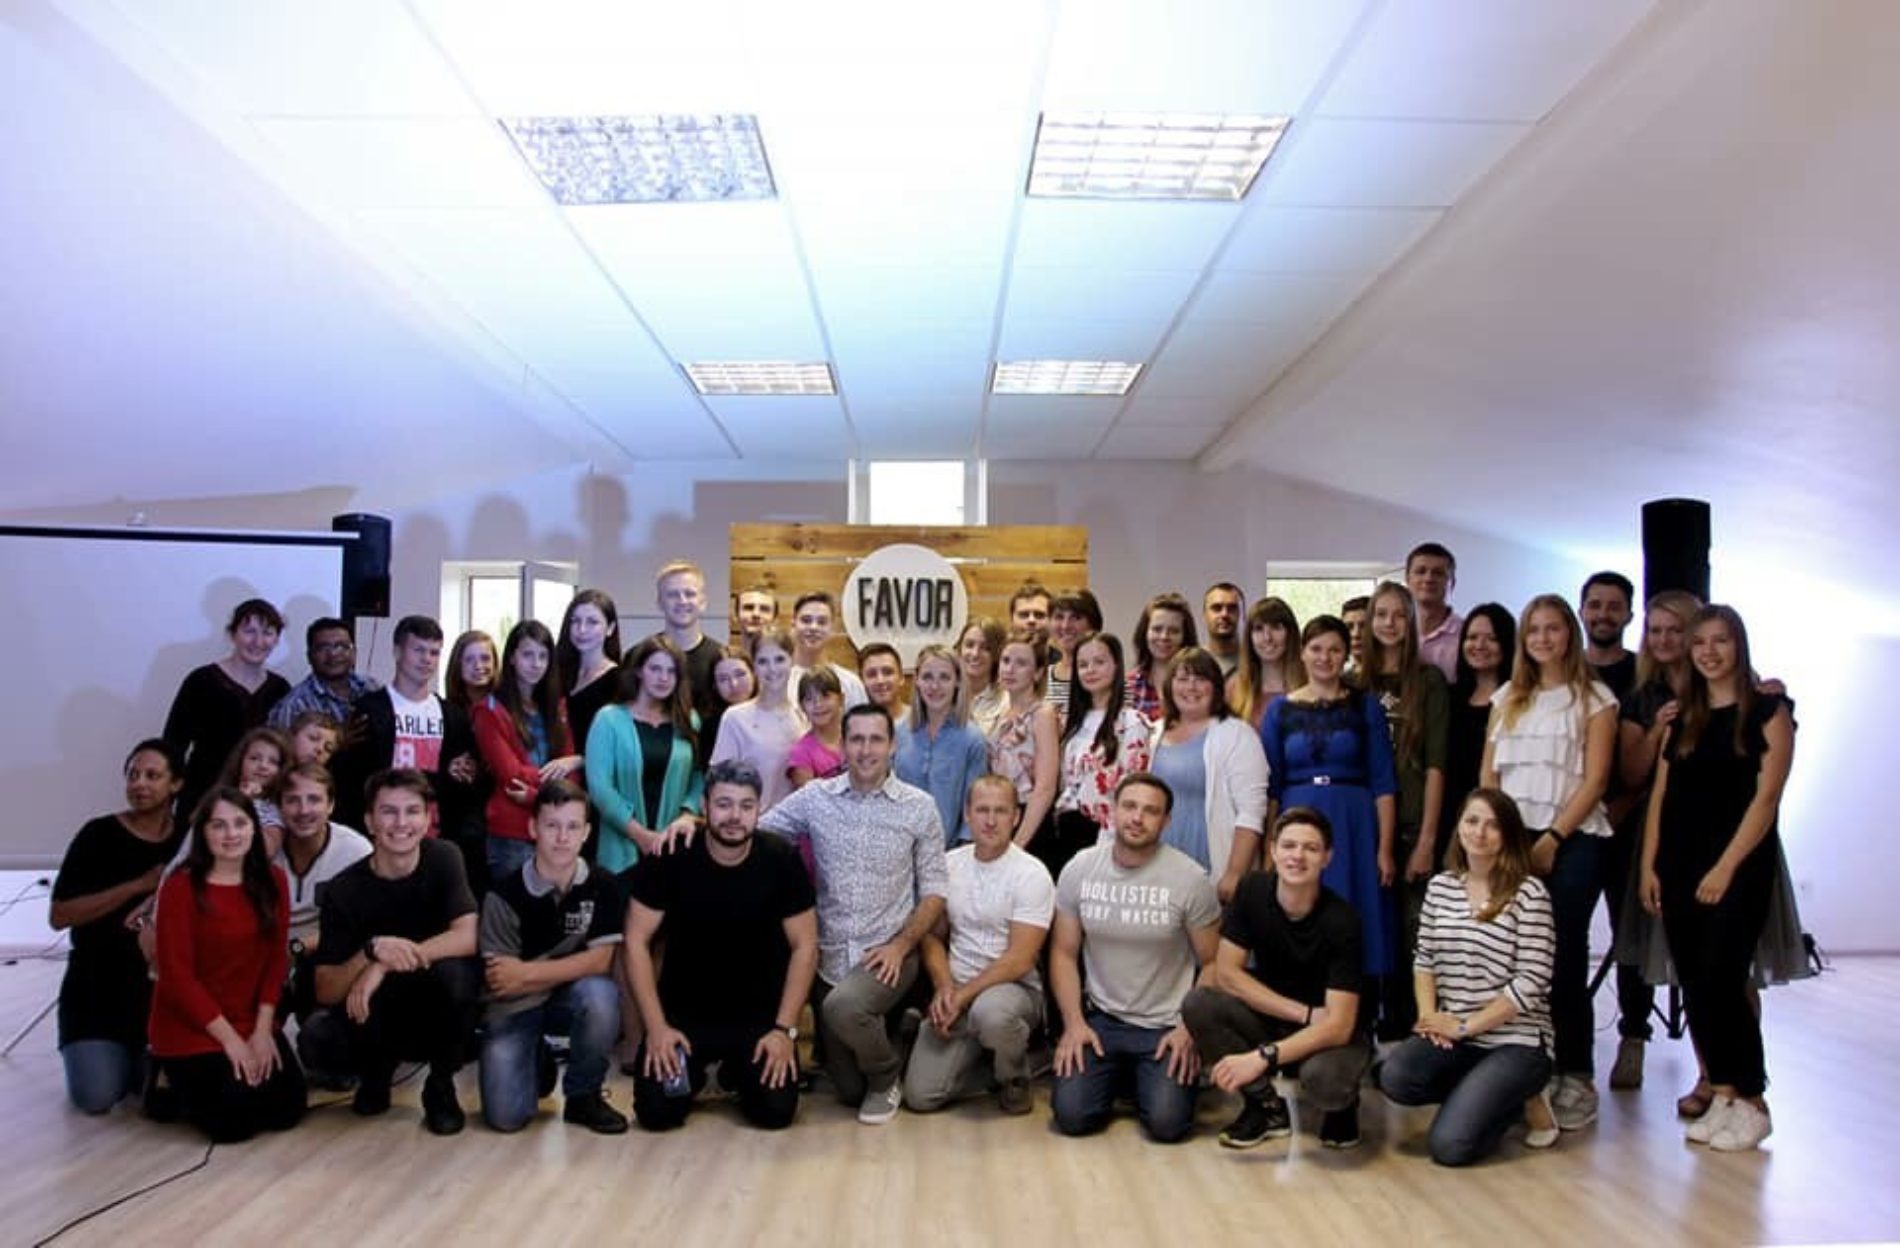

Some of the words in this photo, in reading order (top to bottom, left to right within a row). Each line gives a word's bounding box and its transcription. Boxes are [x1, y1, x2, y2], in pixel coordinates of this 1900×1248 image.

[858, 576, 954, 629] FAVOR
[1080, 879, 1169, 910] HOLLISTER
[1120, 906, 1169, 925] WATCH
